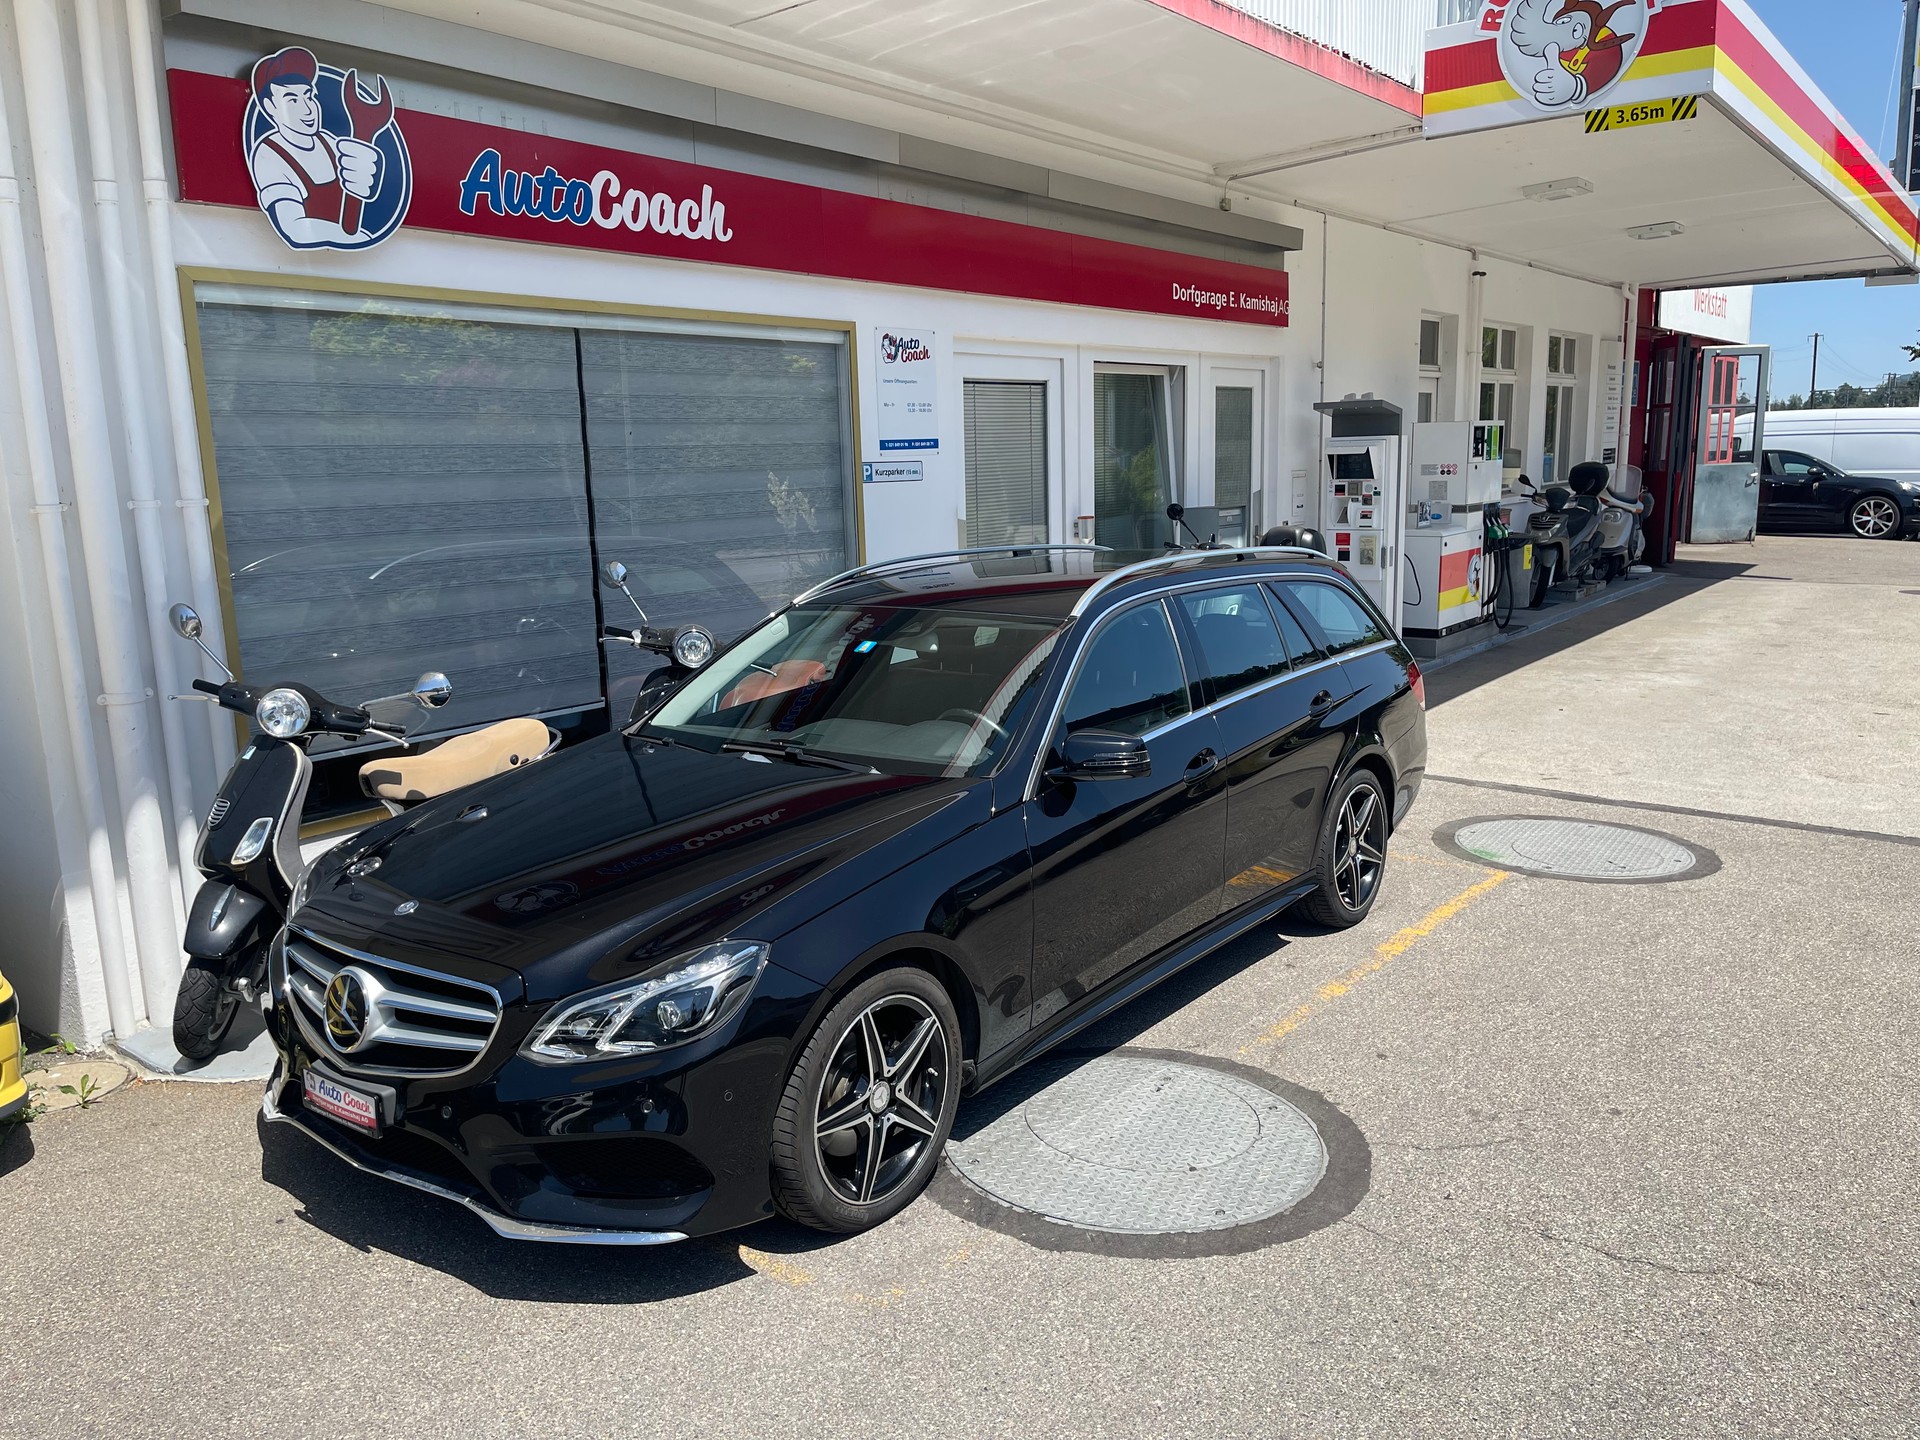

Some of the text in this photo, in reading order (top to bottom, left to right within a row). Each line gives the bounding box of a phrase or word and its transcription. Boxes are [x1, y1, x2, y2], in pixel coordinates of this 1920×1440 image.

[1616, 106, 1665, 125] 3.65m
[1172, 282, 1228, 310] Dorfgarage
[1229, 291, 1238, 308] E.
[1694, 287, 1727, 319] Werkstatt
[897, 336, 920, 353] Auto
[901, 345, 931, 363] Coach
[863, 465, 872, 481] P
[875, 468, 905, 477] Kurzparker
[318, 1080, 370, 1113] Auto Coach
